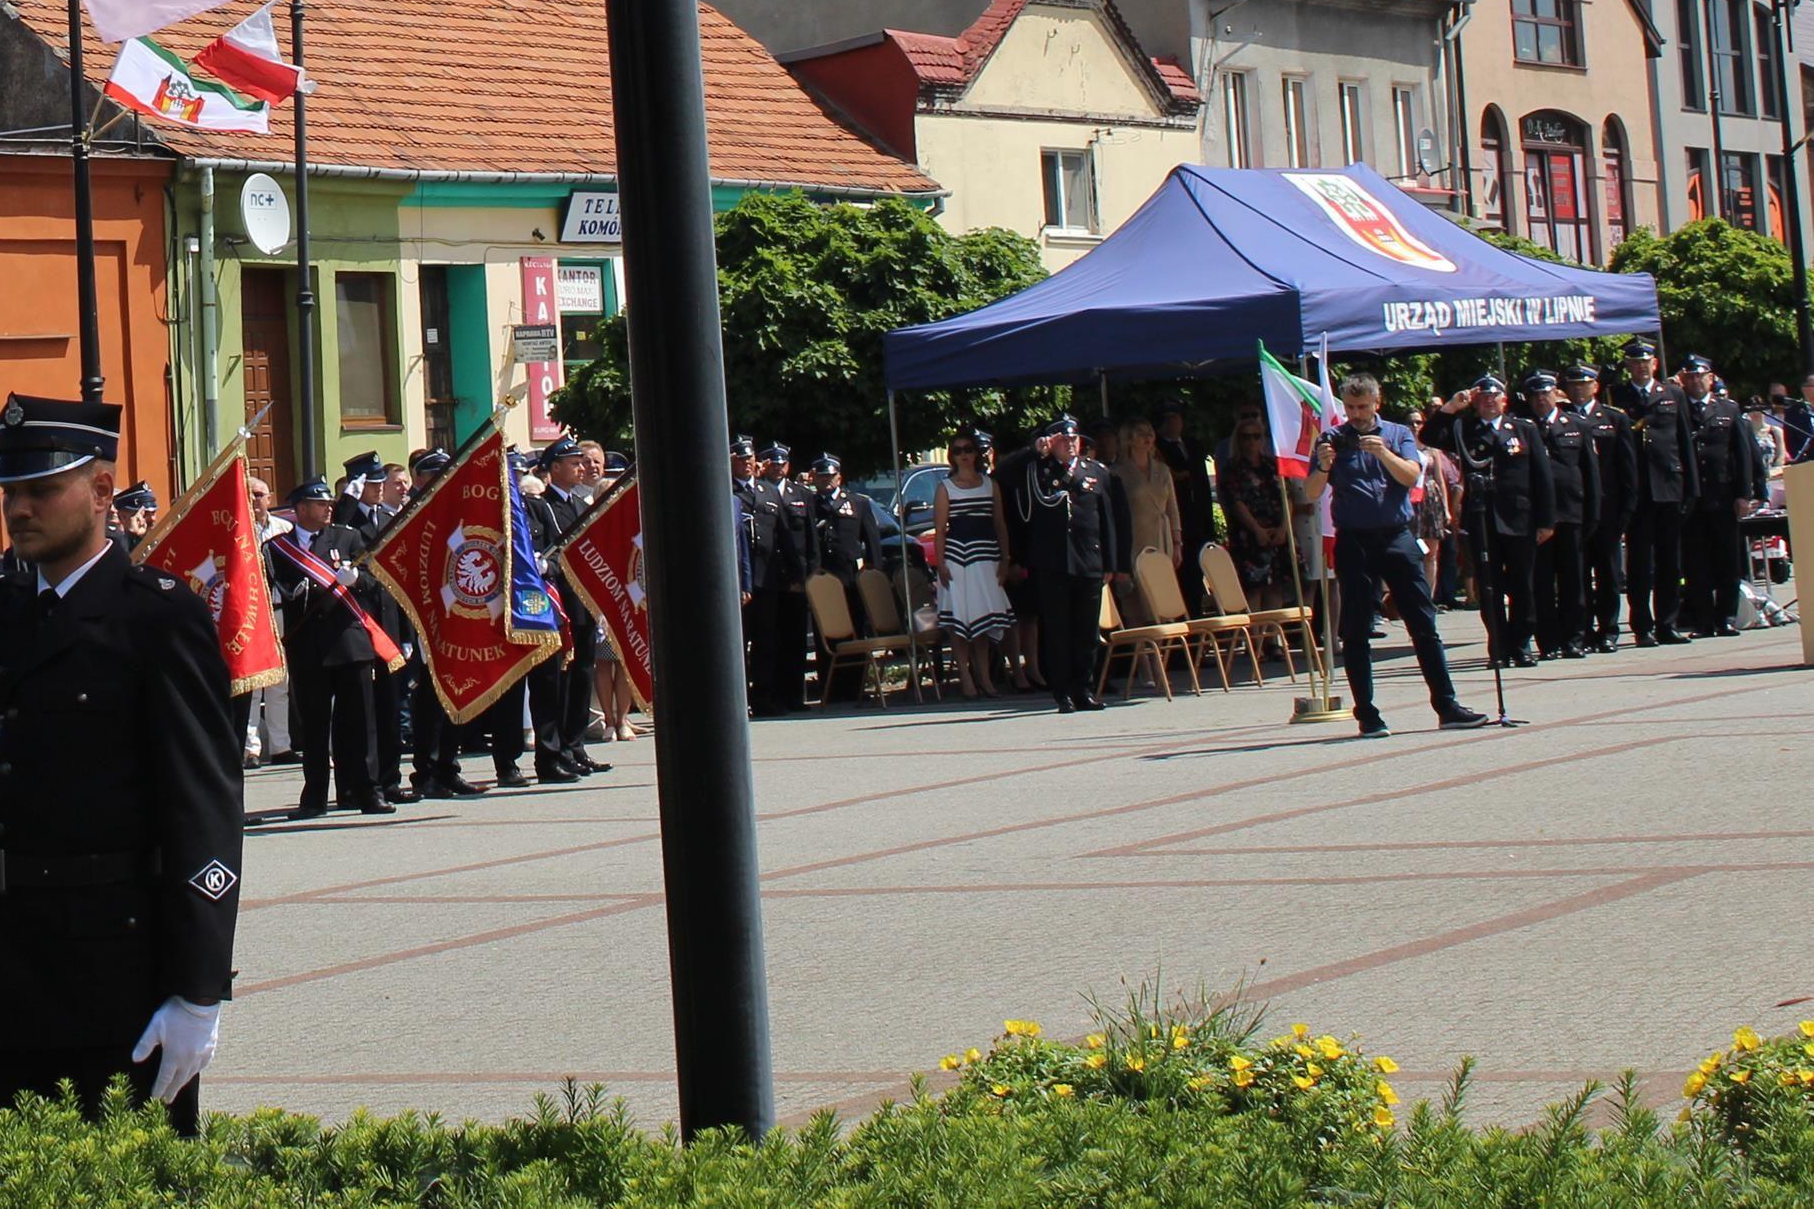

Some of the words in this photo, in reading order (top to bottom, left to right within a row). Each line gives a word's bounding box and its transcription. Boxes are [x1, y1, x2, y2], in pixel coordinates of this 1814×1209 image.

[251, 193, 274, 206] nc+
[585, 198, 620, 214] TEL
[578, 216, 621, 235] KOMÓ
[1383, 301, 1450, 336] URZĄD
[1453, 297, 1524, 327] MIEJSKI
[1526, 296, 1541, 325] W
[1543, 295, 1596, 324] LIPNIE
[418, 520, 437, 607] LUDZIOM
[578, 538, 625, 602] LUDZIOM
